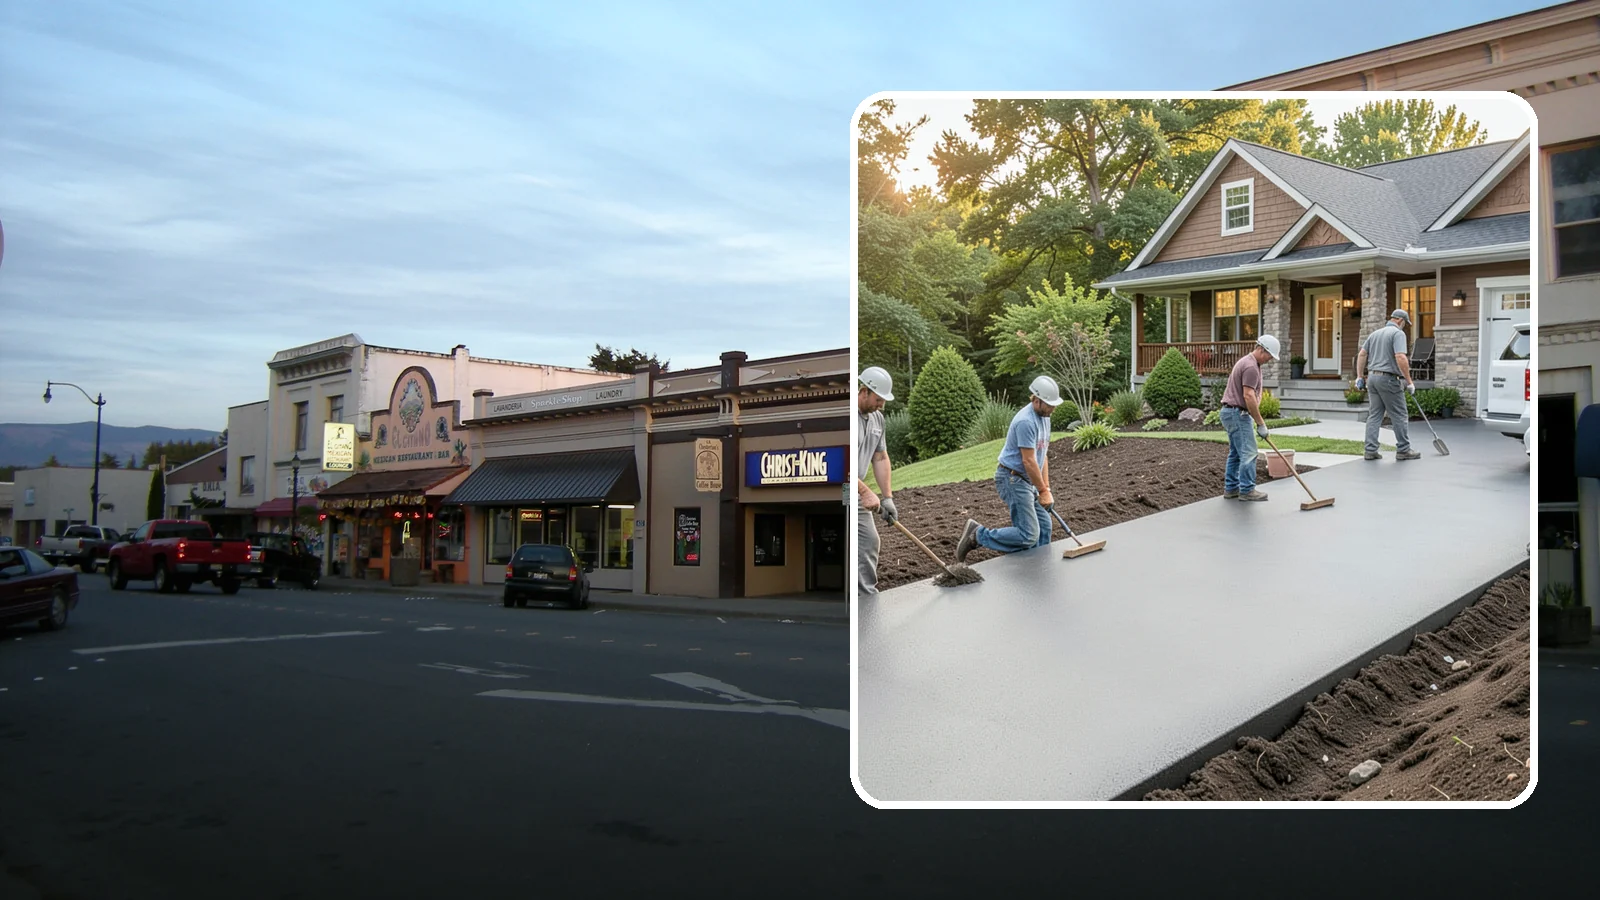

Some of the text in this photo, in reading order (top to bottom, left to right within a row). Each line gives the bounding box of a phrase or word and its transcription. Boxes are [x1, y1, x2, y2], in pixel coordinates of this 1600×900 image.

[493, 389, 623, 413] LAVANDERIA Sparkle Shop LAUNDRY
[373, 450, 450, 464] MEXICAN RESTAURANT BAR
[761, 450, 827, 478] CHRIST KING
